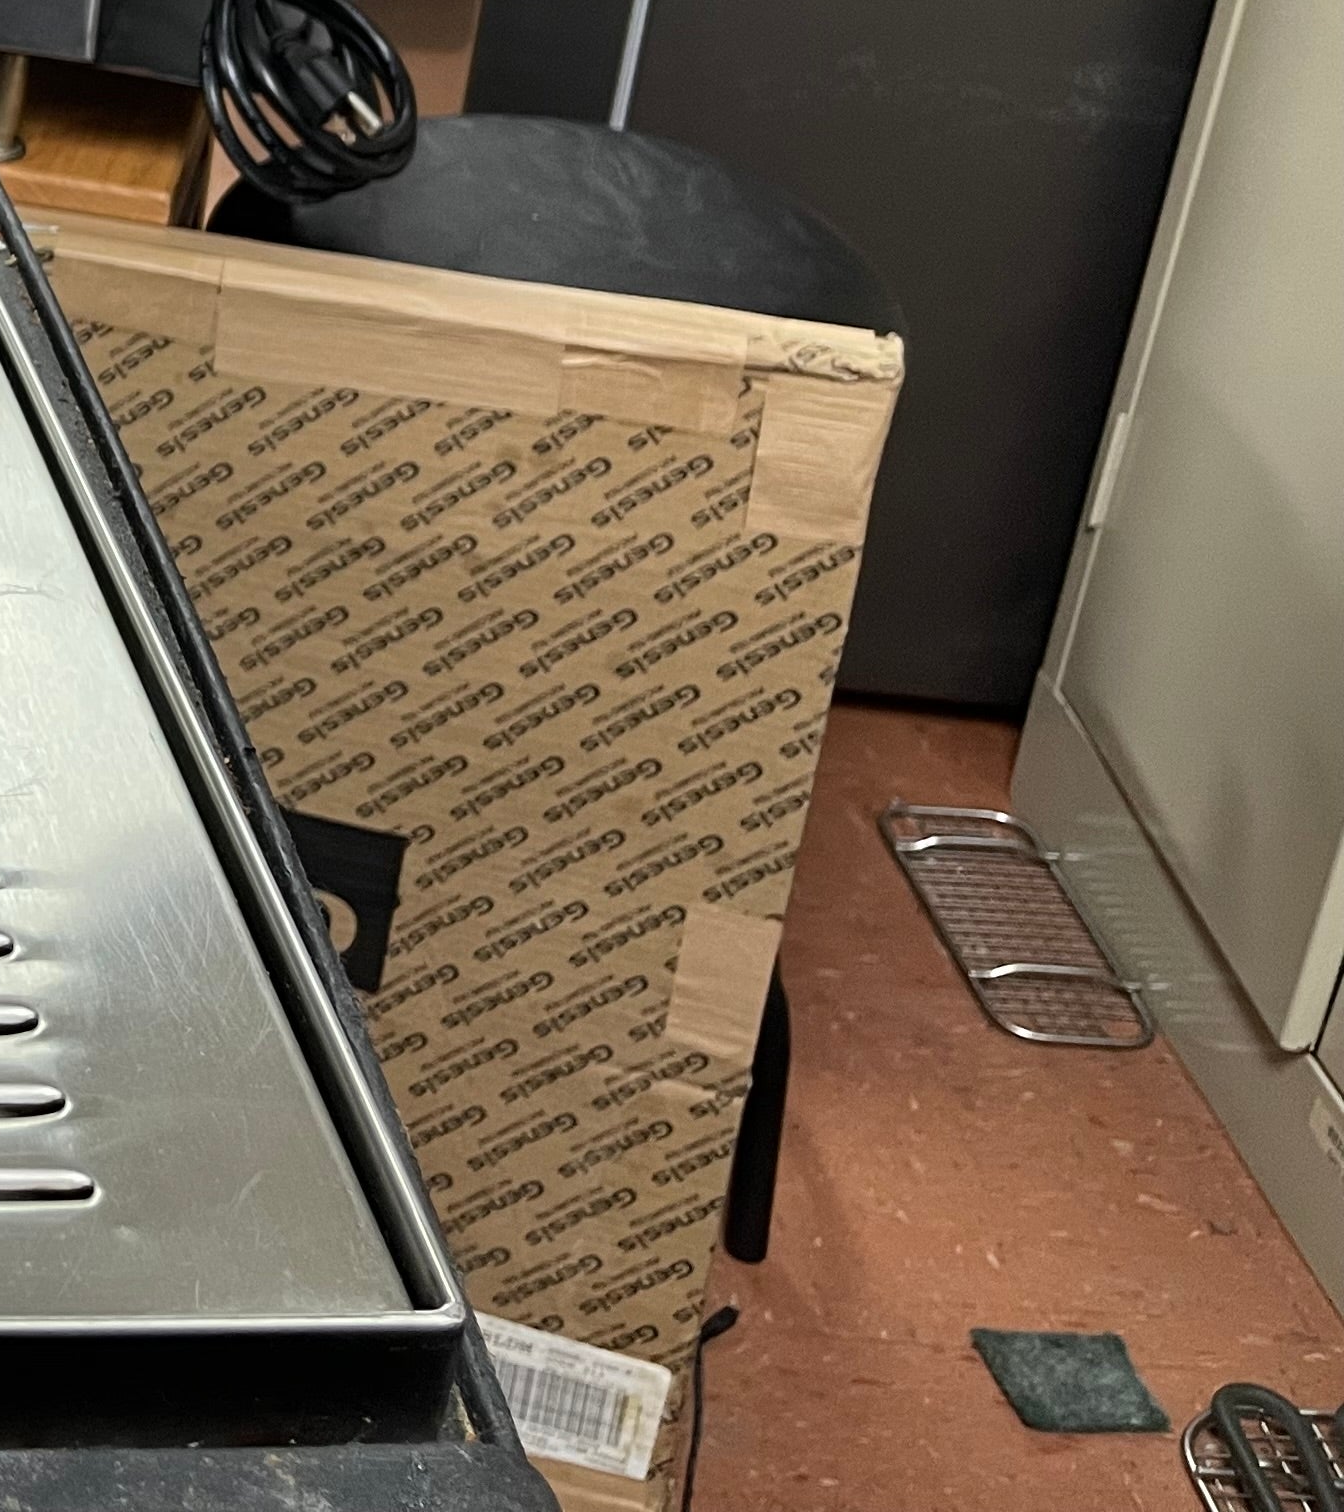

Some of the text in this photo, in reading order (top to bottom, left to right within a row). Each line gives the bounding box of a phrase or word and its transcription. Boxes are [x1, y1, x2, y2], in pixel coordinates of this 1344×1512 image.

[98, 337, 174, 385] nesis
[156, 386, 267, 457] Genesis
[248, 388, 359, 456] Genesis
[340, 399, 446, 457] enesis
[434, 409, 513, 456] nesis
[532, 412, 605, 455] esis
[151, 462, 234, 515] Genes
[216, 462, 326, 530] Genesis
[306, 462, 420, 530] Genesis
[400, 460, 517, 532] Genesis
[492, 457, 612, 529] Genesis
[591, 454, 714, 528] Genesis
[275, 536, 386, 603] Genesis
[362, 534, 478, 601] Genesis
[458, 534, 576, 603] Genesis
[553, 533, 674, 604] Genesis
[654, 533, 779, 604] Genesis
[754, 545, 861, 607] enesis
[239, 606, 349, 671] Genesis
[331, 607, 444, 675] Genesis
[422, 609, 539, 676] Genesis
[519, 608, 638, 679] Genesis
[613, 611, 739, 679] Genesis
[716, 613, 842, 681] Genesis
[241, 677, 317, 724] Gene
[297, 681, 409, 744] Genesis
[390, 682, 504, 750] Genesis
[482, 684, 601, 750] Genesis
[580, 685, 701, 752] Genesis
[678, 688, 802, 755] Genesis
[277, 751, 375, 808] Genesi
[356, 755, 469, 817] Genesis
[450, 756, 565, 822] Genesis
[543, 758, 663, 823] Genesis
[641, 761, 763, 827] Genesis
[416, 826, 528, 889] Genesis
[509, 829, 626, 896] Genesis
[603, 834, 724, 897] Genesis
[702, 850, 796, 903] enesis
[473, 901, 589, 962] Genesis
[568, 905, 687, 968] Genesis
[367, 964, 460, 1020] Genesi
[440, 971, 554, 1029] Genesis
[532, 975, 649, 1038] Genesis
[408, 1039, 519, 1097] Genesis
[499, 1044, 614, 1105] Genesis
[590, 1052, 710, 1111] Genesis
[467, 1112, 578, 1172] Genesis
[557, 1120, 674, 1178] Genesis
[652, 1139, 737, 1186] nesis
[525, 1187, 637, 1246] Genesis
[490, 1254, 603, 1312] Genesis
[578, 1259, 694, 1320] Genesis
